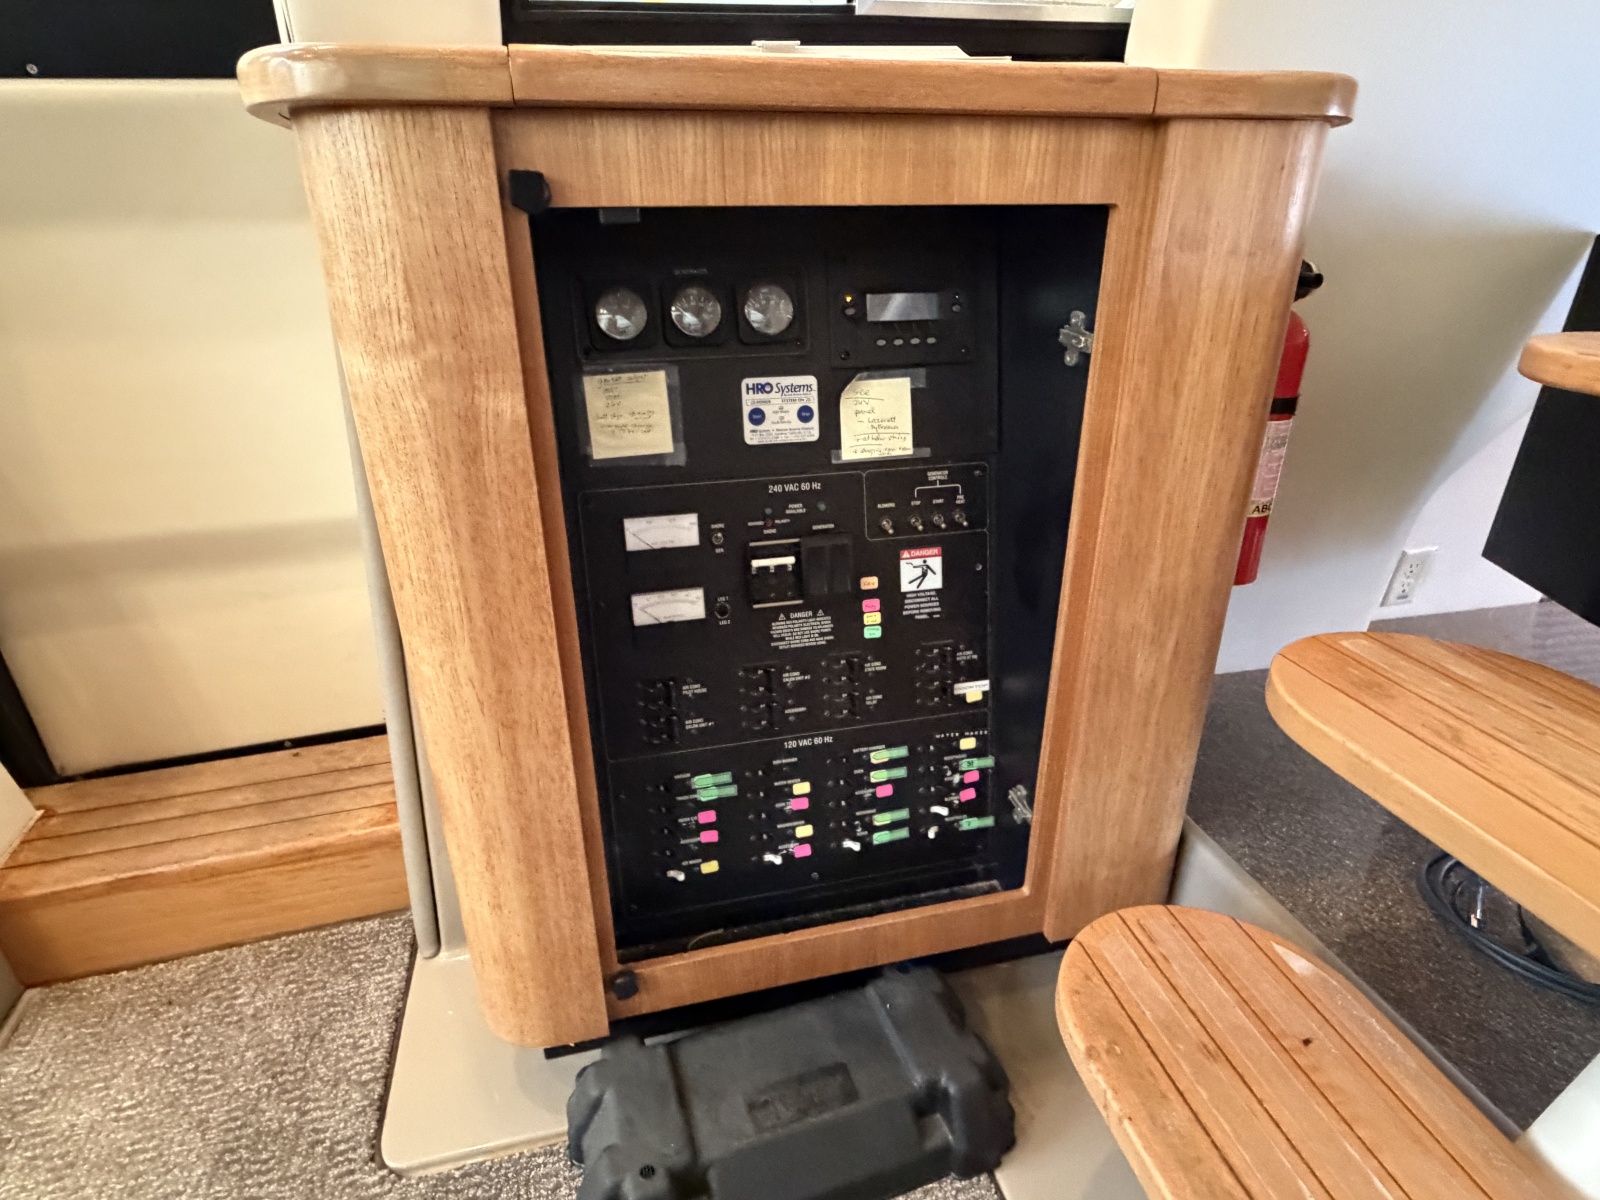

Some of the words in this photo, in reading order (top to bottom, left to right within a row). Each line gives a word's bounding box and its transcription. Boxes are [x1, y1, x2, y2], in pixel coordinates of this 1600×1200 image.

[746, 382, 774, 395] HRO
[774, 382, 813, 396] Systems
[768, 485, 782, 493] 240
[784, 483, 799, 492] VAC
[801, 482, 810, 490] 60
[812, 482, 821, 490] Hz
[910, 549, 938, 557] DANGER
